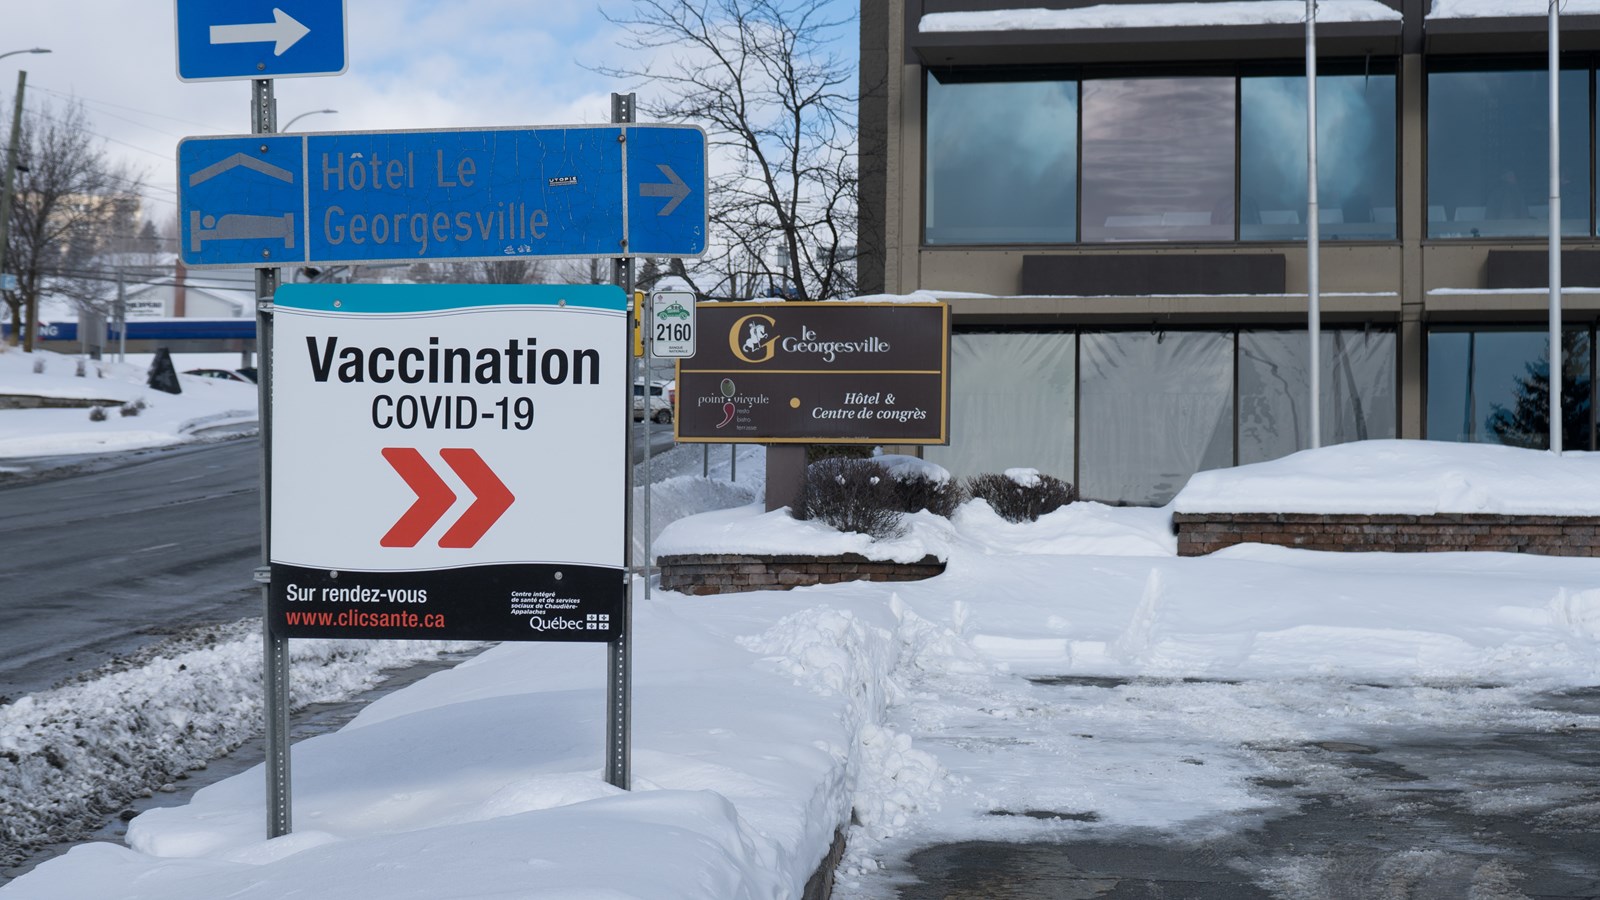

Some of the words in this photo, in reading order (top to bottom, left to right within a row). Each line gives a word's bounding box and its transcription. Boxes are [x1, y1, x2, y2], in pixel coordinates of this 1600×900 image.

[322, 151, 414, 191] Hôtel
[437, 149, 477, 188] Le
[324, 202, 549, 255] Georgesville
[656, 323, 691, 342] 2160
[802, 325, 817, 341] le
[782, 336, 890, 363] Georgesville
[305, 336, 600, 385] Vaccination
[697, 392, 725, 407] point
[733, 393, 769, 408] virgule
[844, 392, 880, 405] Hôtel
[884, 393, 896, 405] &
[371, 394, 535, 431] COVID-19
[812, 407, 855, 419] Centre
[857, 407, 873, 419] de
[876, 407, 927, 423] congrès
[286, 584, 316, 601] Sur
[322, 585, 428, 603] rendez-vous
[286, 609, 445, 628] www.clicsante.ca
[530, 616, 584, 632] Québec
